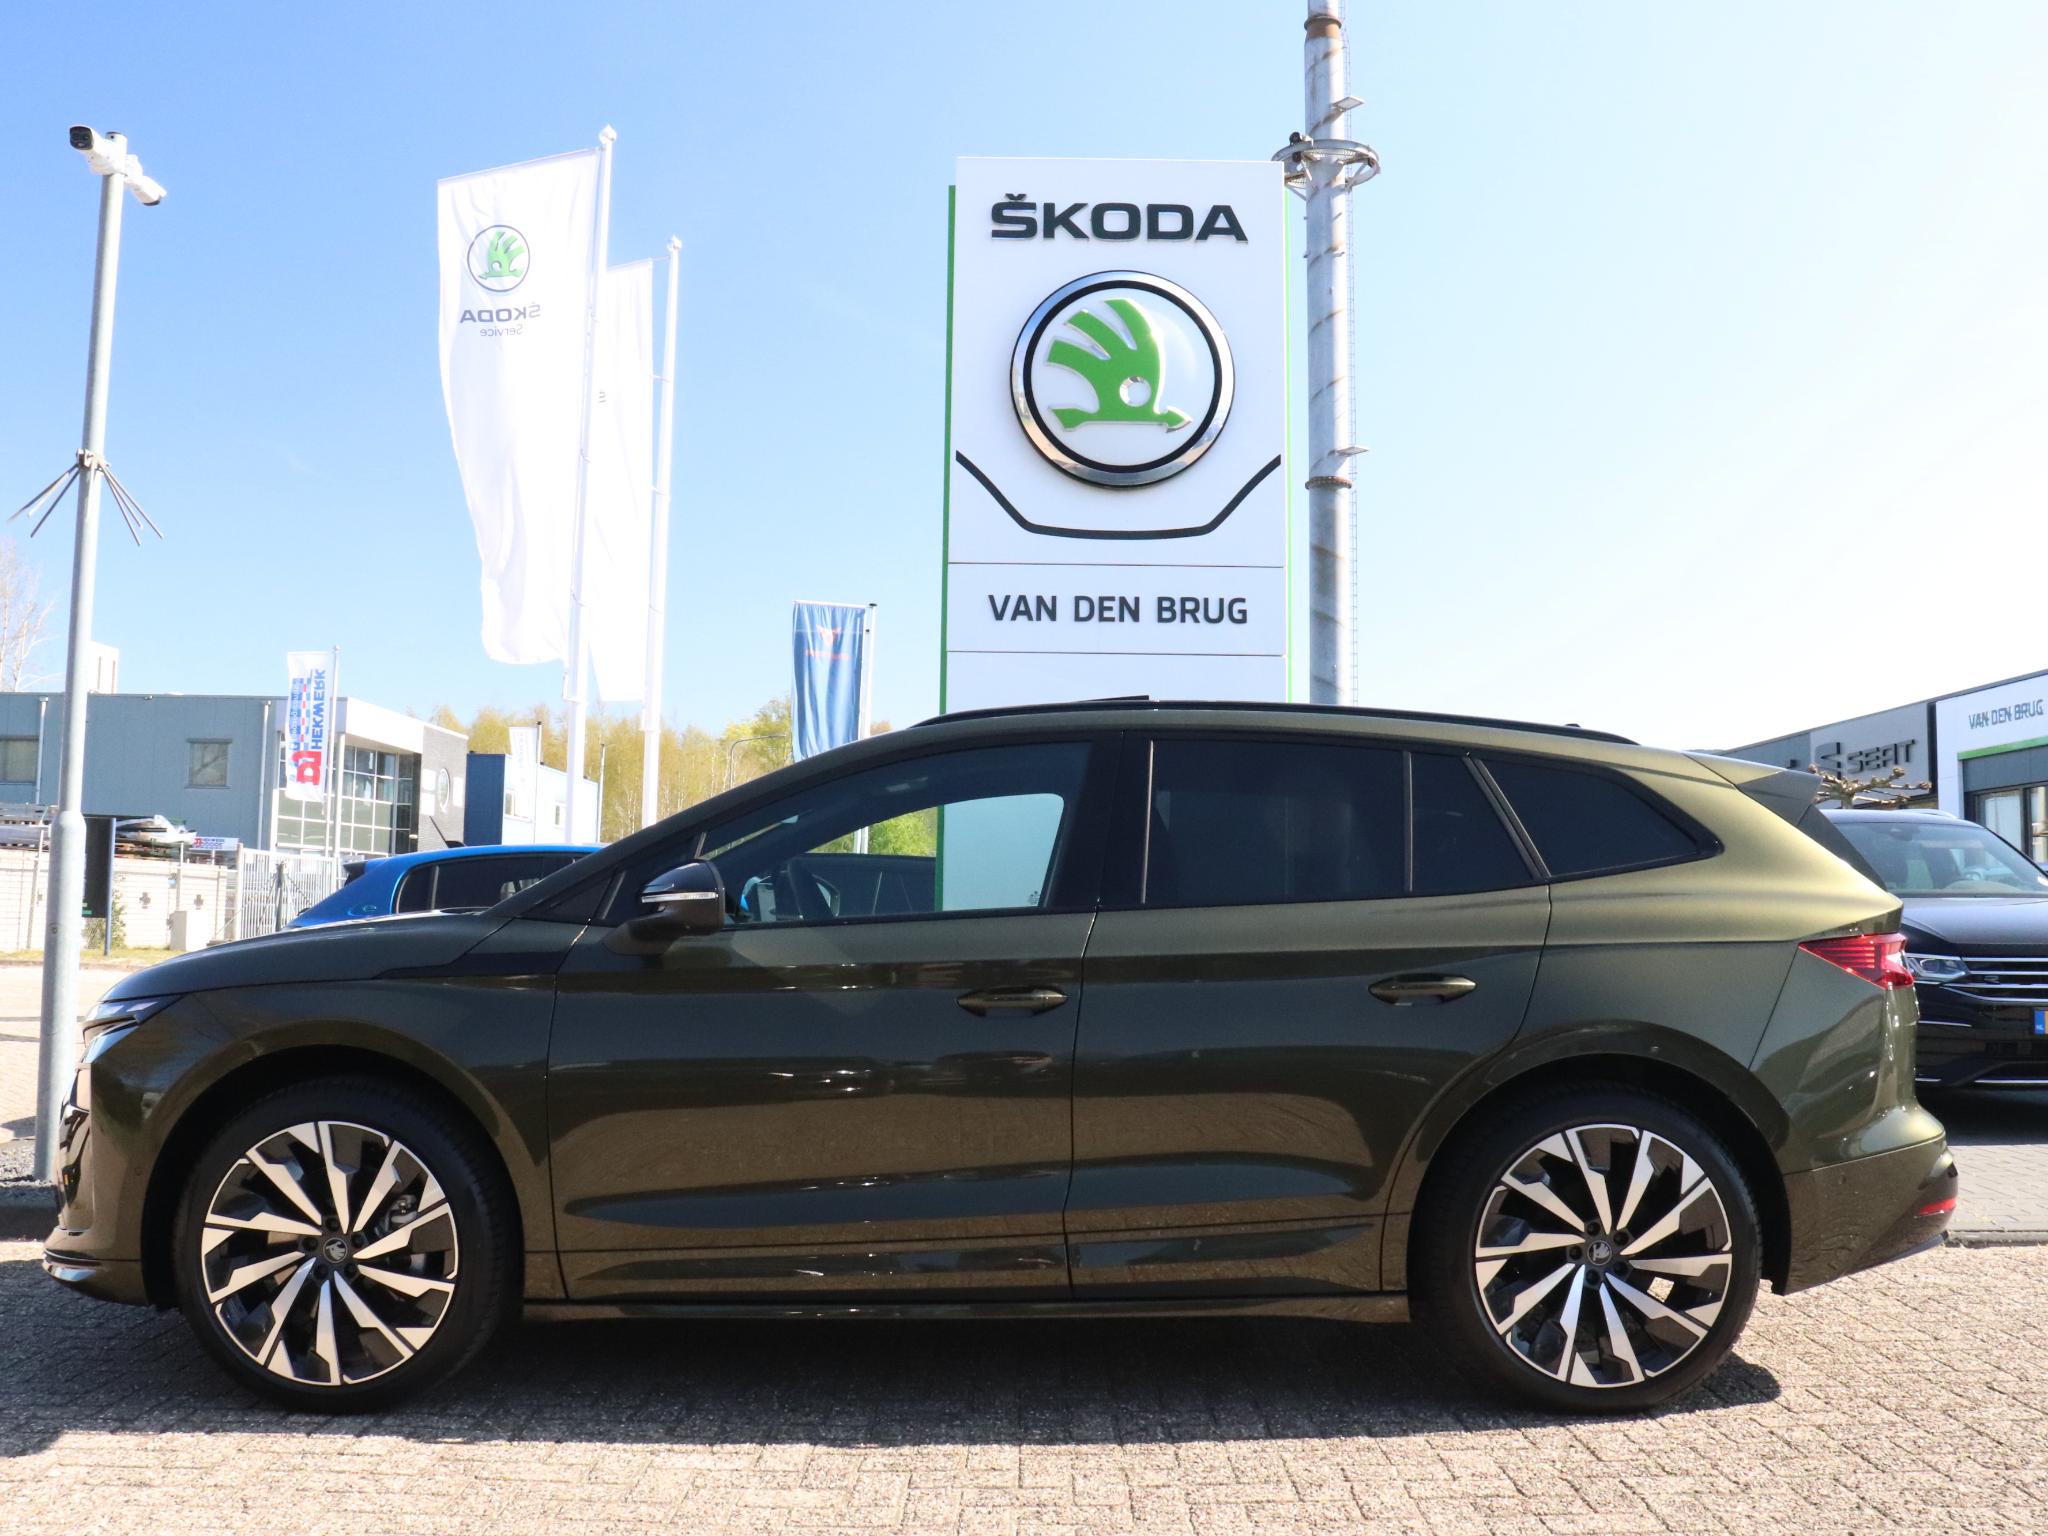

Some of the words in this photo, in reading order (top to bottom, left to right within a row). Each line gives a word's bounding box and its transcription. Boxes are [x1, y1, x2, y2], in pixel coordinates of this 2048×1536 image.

[991, 193, 1248, 241] ŠKODA
[988, 594, 1057, 621] VAN
[1074, 595, 1140, 622] DEN
[1157, 596, 1248, 624] BRUG
[1968, 711, 1990, 730] VAN
[1991, 706, 2012, 726] DEN
[2014, 699, 2044, 721] BRUG
[1847, 739, 1916, 774] SEAT
